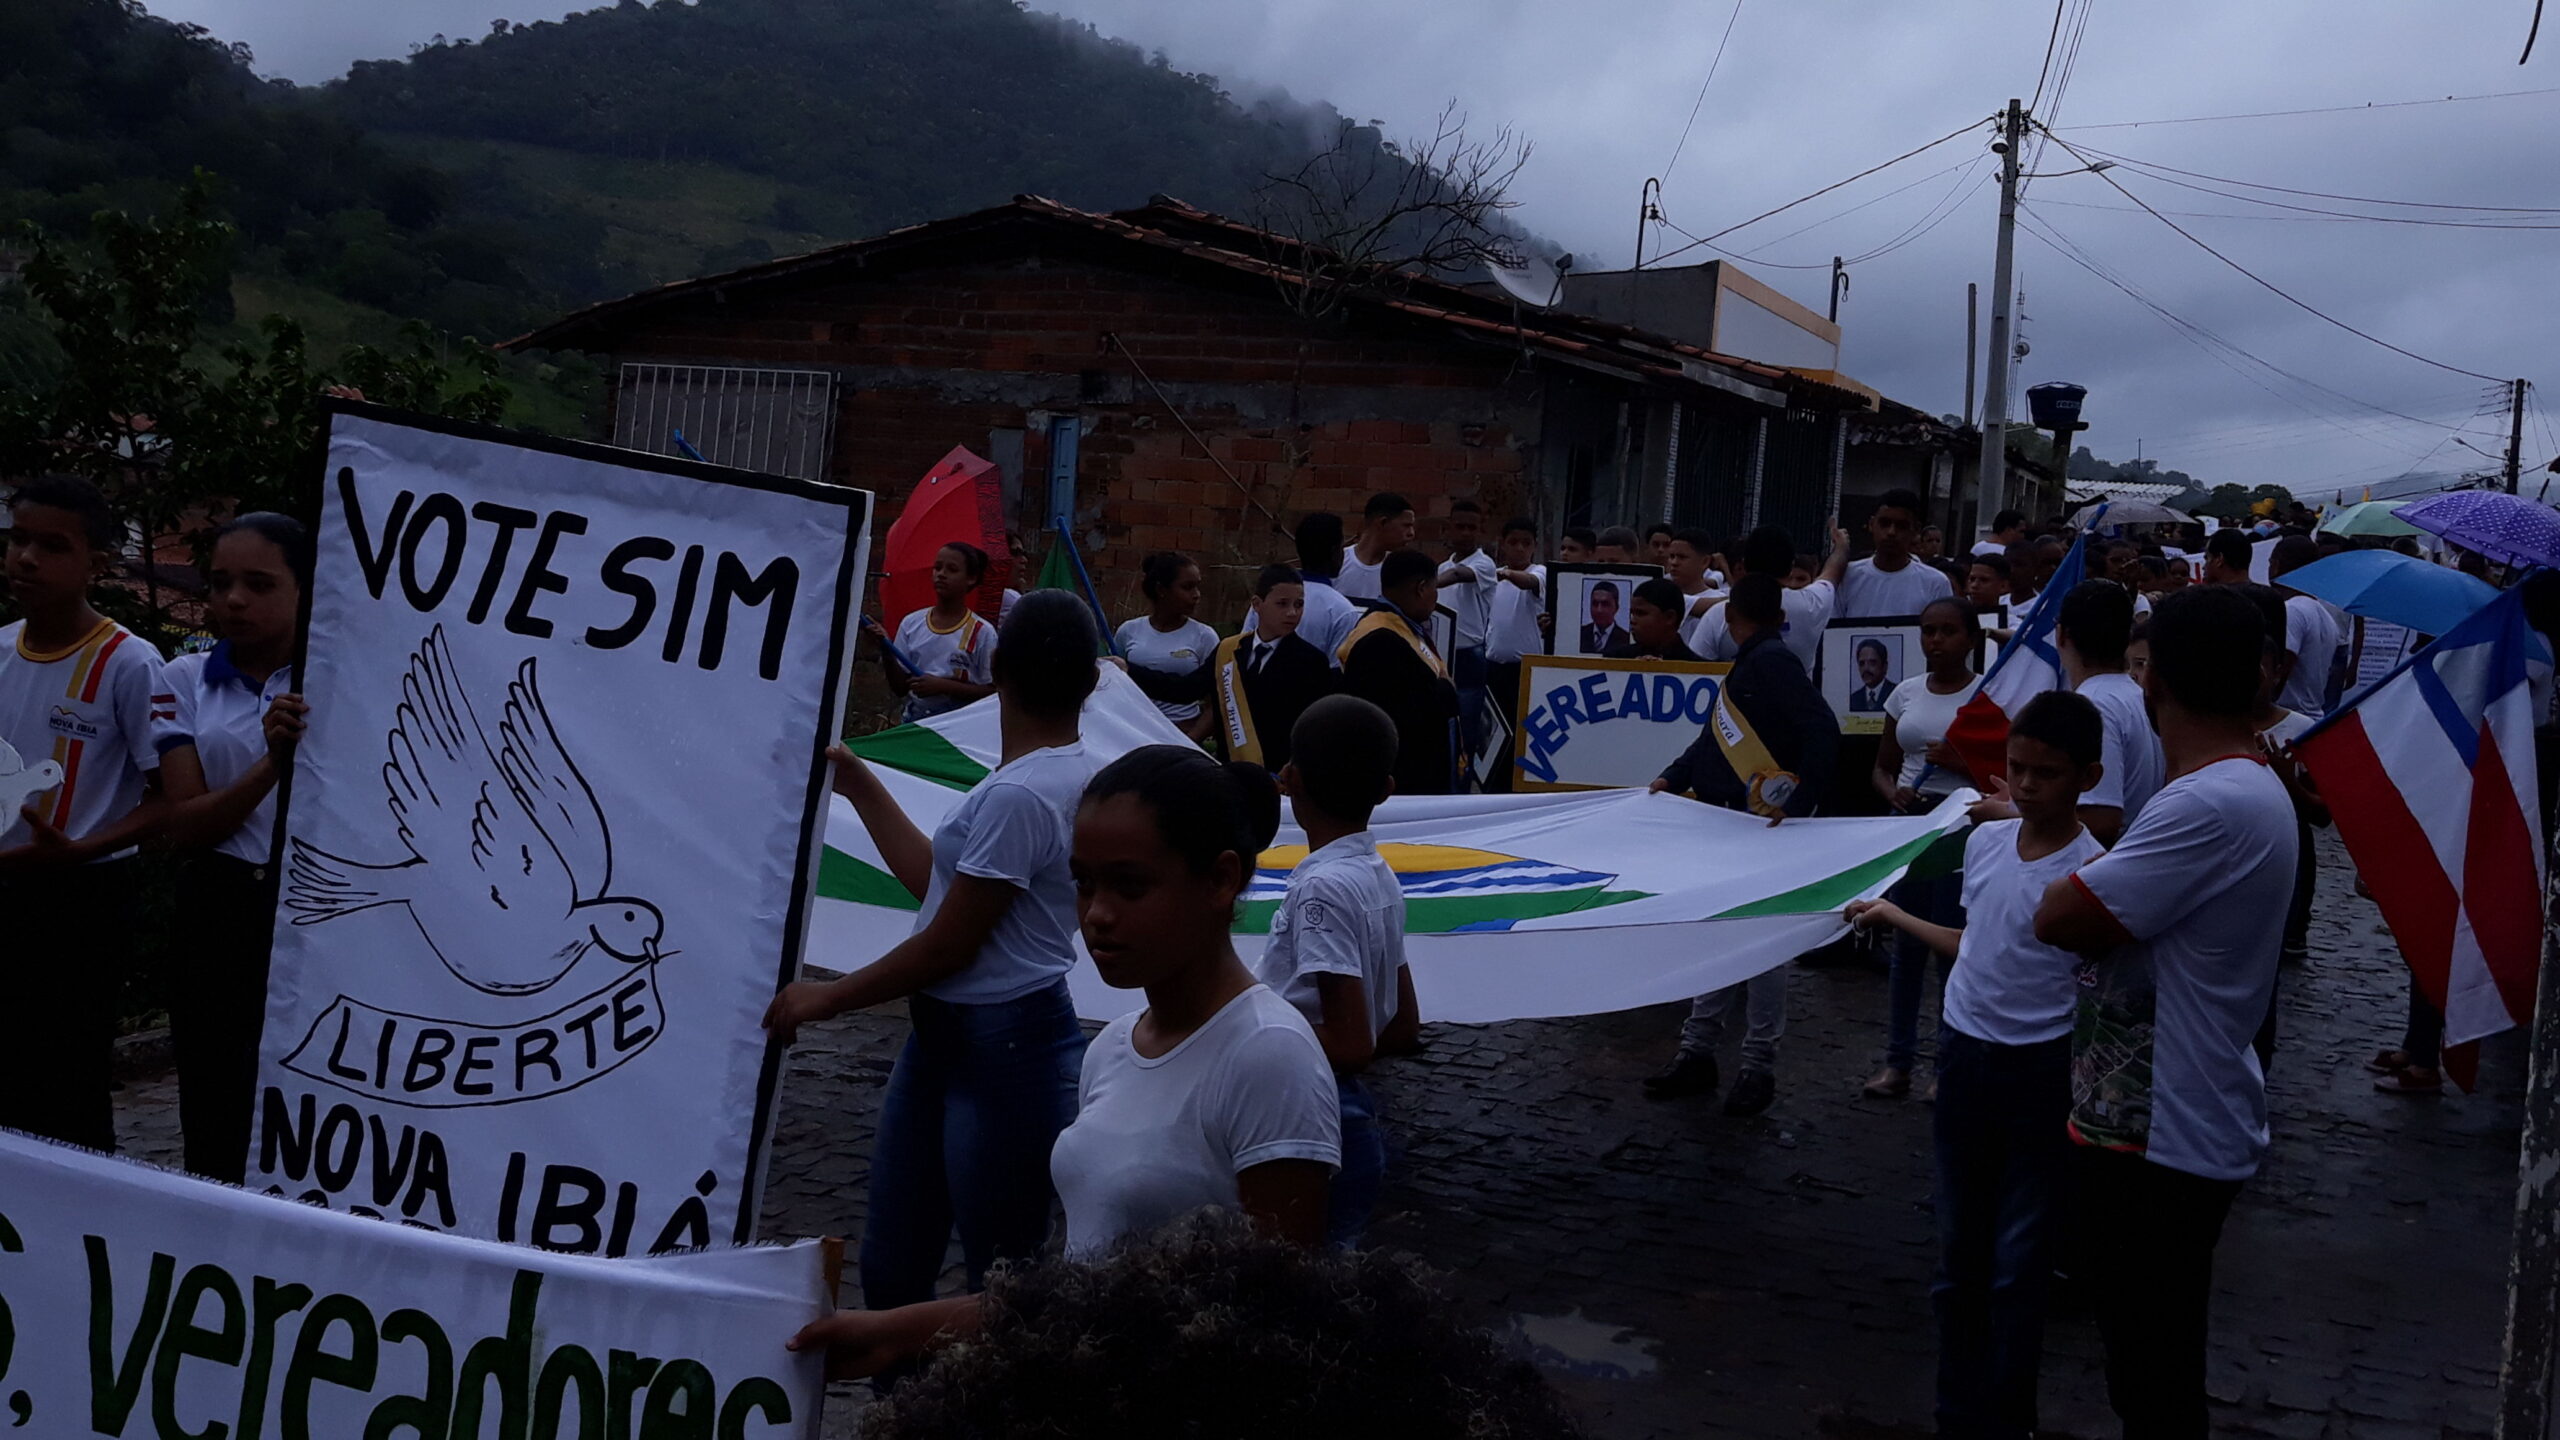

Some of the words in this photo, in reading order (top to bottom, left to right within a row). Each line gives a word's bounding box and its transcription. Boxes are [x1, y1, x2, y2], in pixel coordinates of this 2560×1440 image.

[338, 467, 588, 638] VOTE
[585, 536, 799, 680] SIM
[50, 717, 74, 730] NOVA
[328, 979, 655, 1095] LIBERTE
[259, 1087, 457, 1228] NOVA
[498, 1152, 718, 1258] IBIÁ
